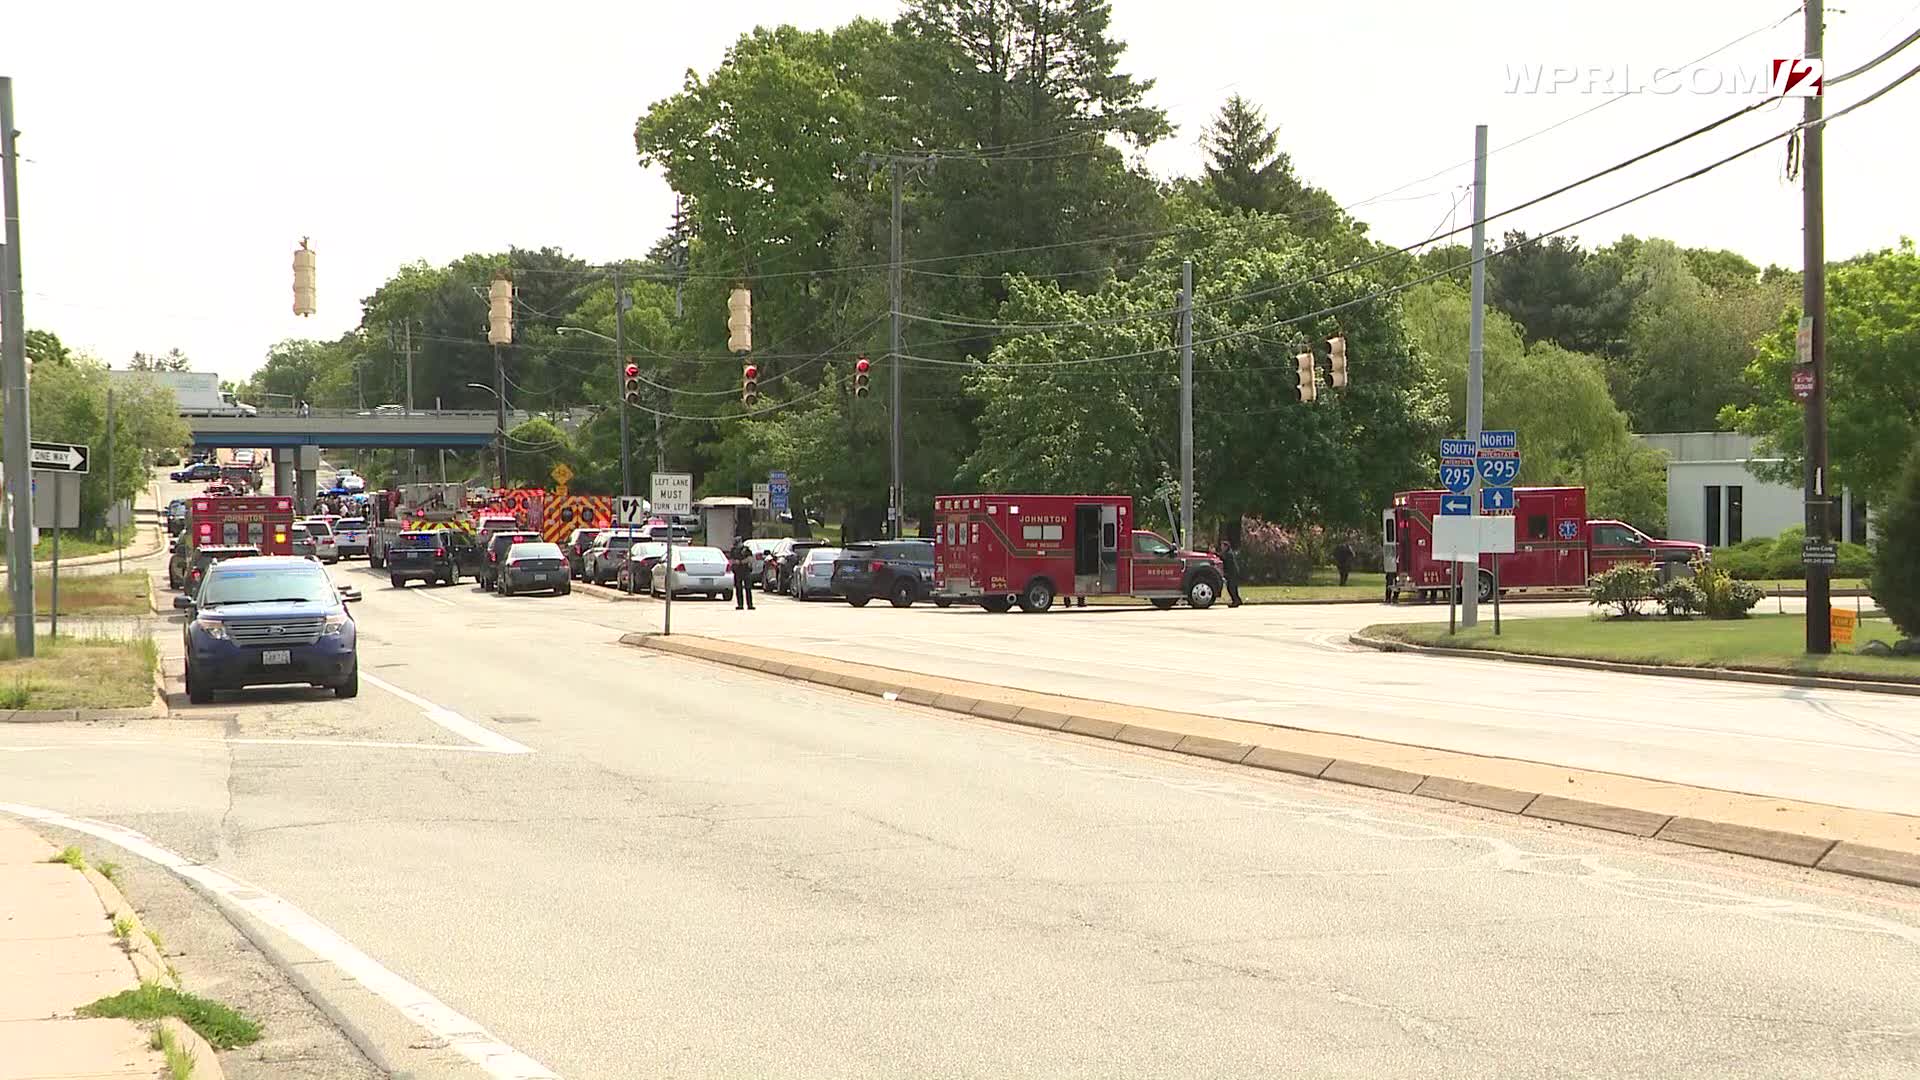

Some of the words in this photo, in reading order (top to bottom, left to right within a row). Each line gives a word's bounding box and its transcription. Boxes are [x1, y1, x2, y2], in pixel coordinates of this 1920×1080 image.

[1481, 433, 1514, 446] NORTH
[1442, 443, 1475, 455] SOUTH
[34, 451, 51, 461] ONE
[52, 452, 70, 462] WAY
[1483, 460, 1515, 478] 295
[1445, 468, 1470, 485] 295
[655, 478, 669, 486] LEFT
[672, 479, 689, 487] LANE
[772, 484, 787, 494] 295
[660, 490, 682, 499] MUST
[654, 502, 670, 510] TURN
[673, 503, 688, 511] LEFT
[755, 498, 766, 508] 14
[223, 514, 265, 522] JOHNSTON
[1019, 515, 1068, 523] JOHNSTON
